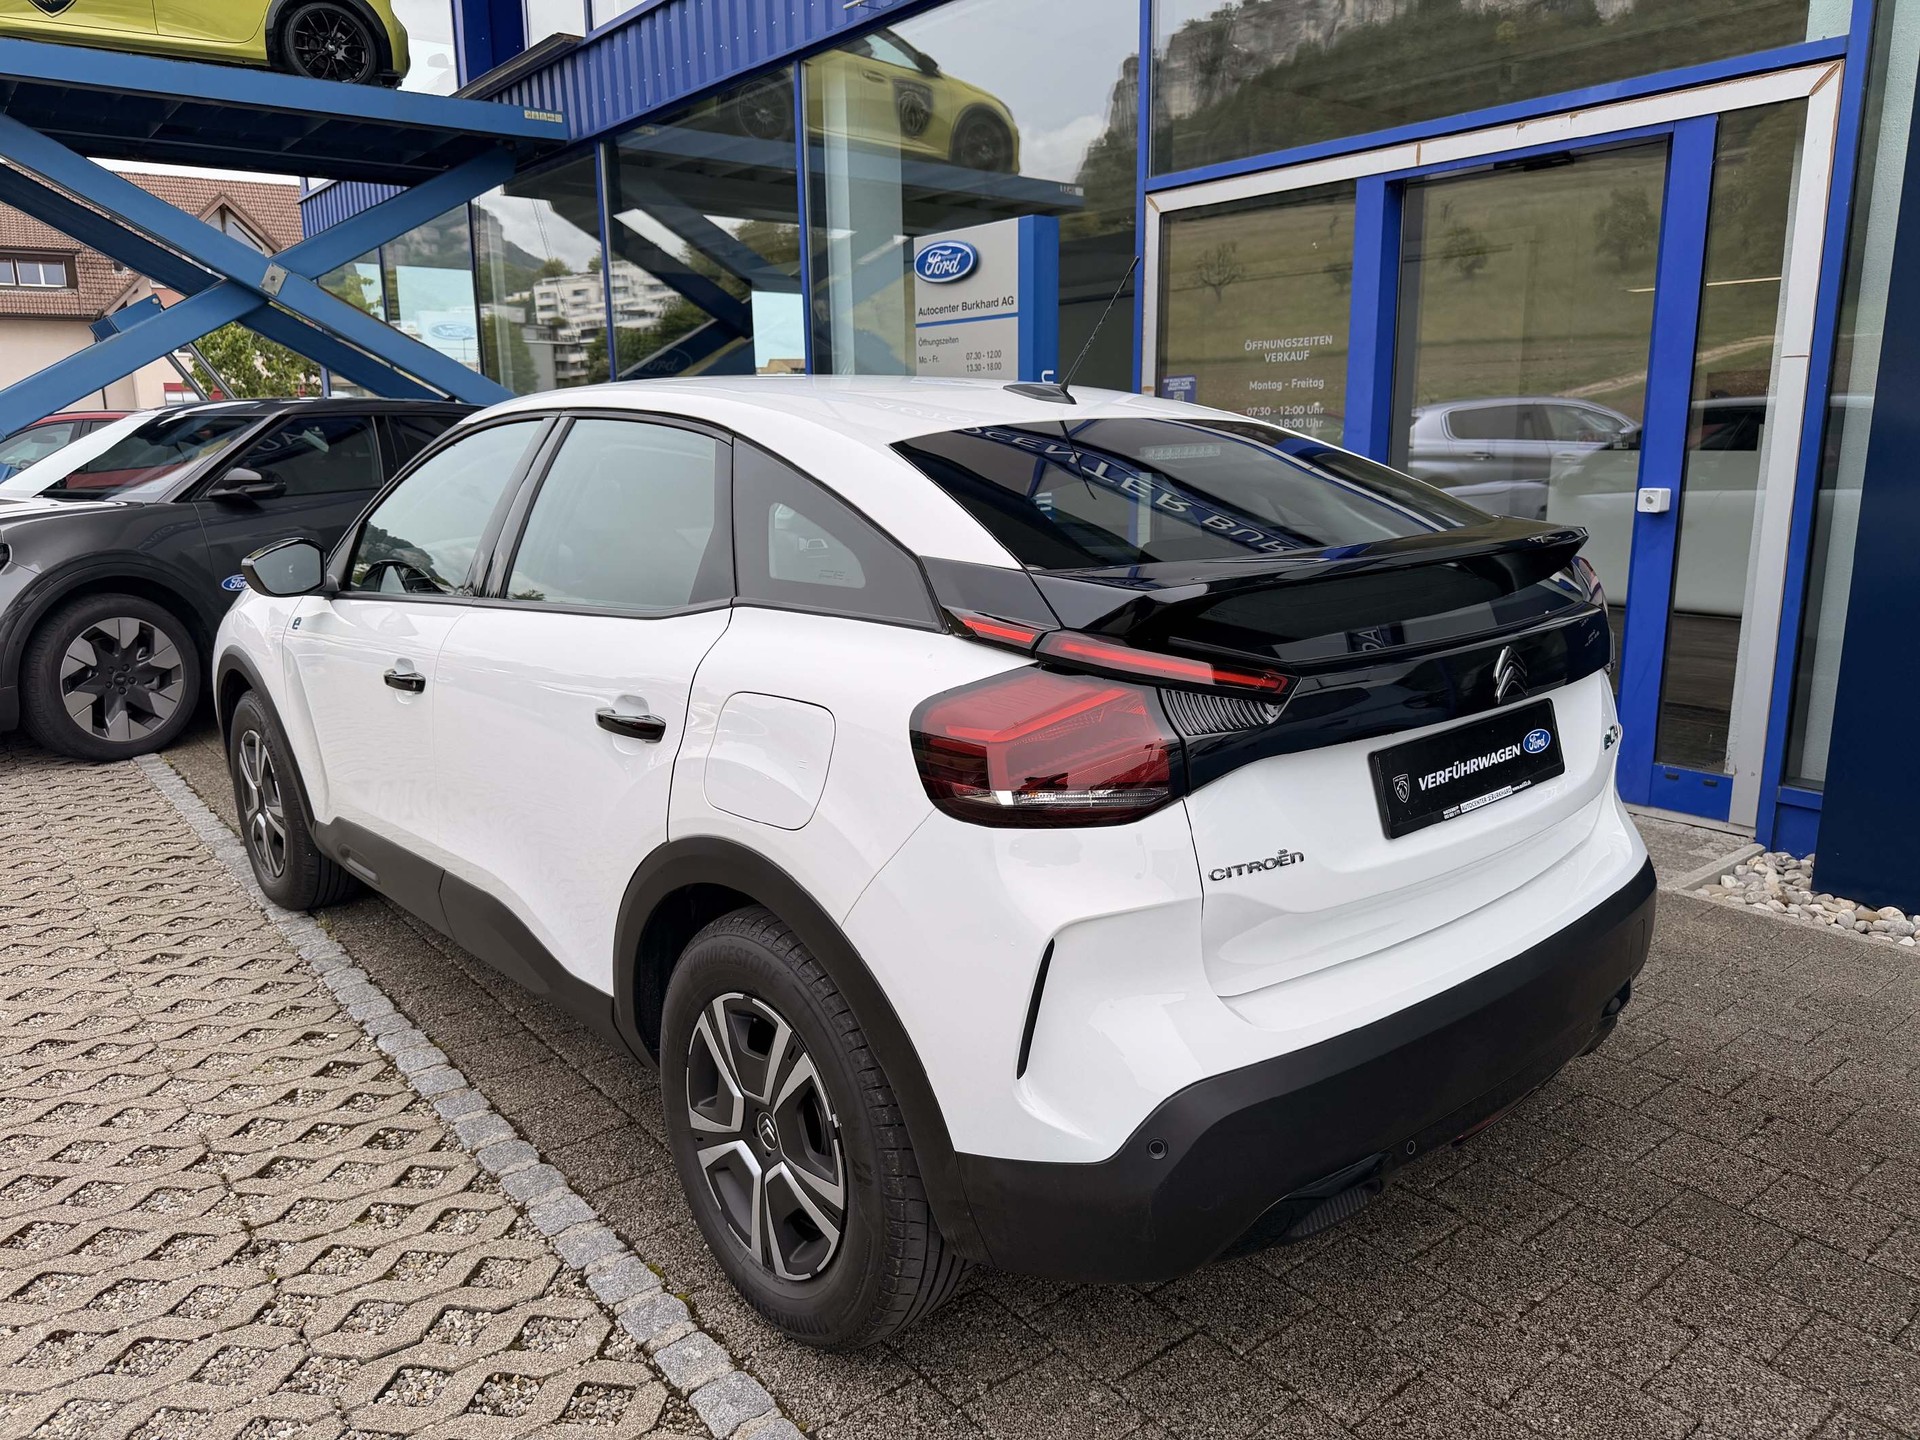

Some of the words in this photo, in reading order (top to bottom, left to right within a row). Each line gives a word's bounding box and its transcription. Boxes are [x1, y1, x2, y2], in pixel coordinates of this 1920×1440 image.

[925, 248, 961, 275] Ford
[918, 304, 959, 316] Autocenter
[961, 298, 999, 311] Burkhard
[1001, 296, 1014, 306] AG
[918, 336, 959, 347] Öffnungszeiten
[1244, 335, 1333, 351] ÖFFNUNGSZEITEN
[965, 351, 982, 360] 07.30
[986, 349, 1002, 359] 12.00
[1264, 350, 1310, 362] VERKAUF
[966, 363, 981, 372] 13.30
[986, 362, 1002, 371] 18.00
[1249, 380, 1283, 391] Montag
[1291, 378, 1325, 390] Freitag
[1246, 406, 1271, 417] 07:30
[1279, 405, 1304, 415] 12:00
[1306, 405, 1324, 415] Uhr
[1279, 418, 1304, 428] 18:00
[1306, 418, 1324, 428] Uhr
[1418, 743, 1521, 792] VERFÜHRWAGEN
[1528, 732, 1546, 750] Ford
